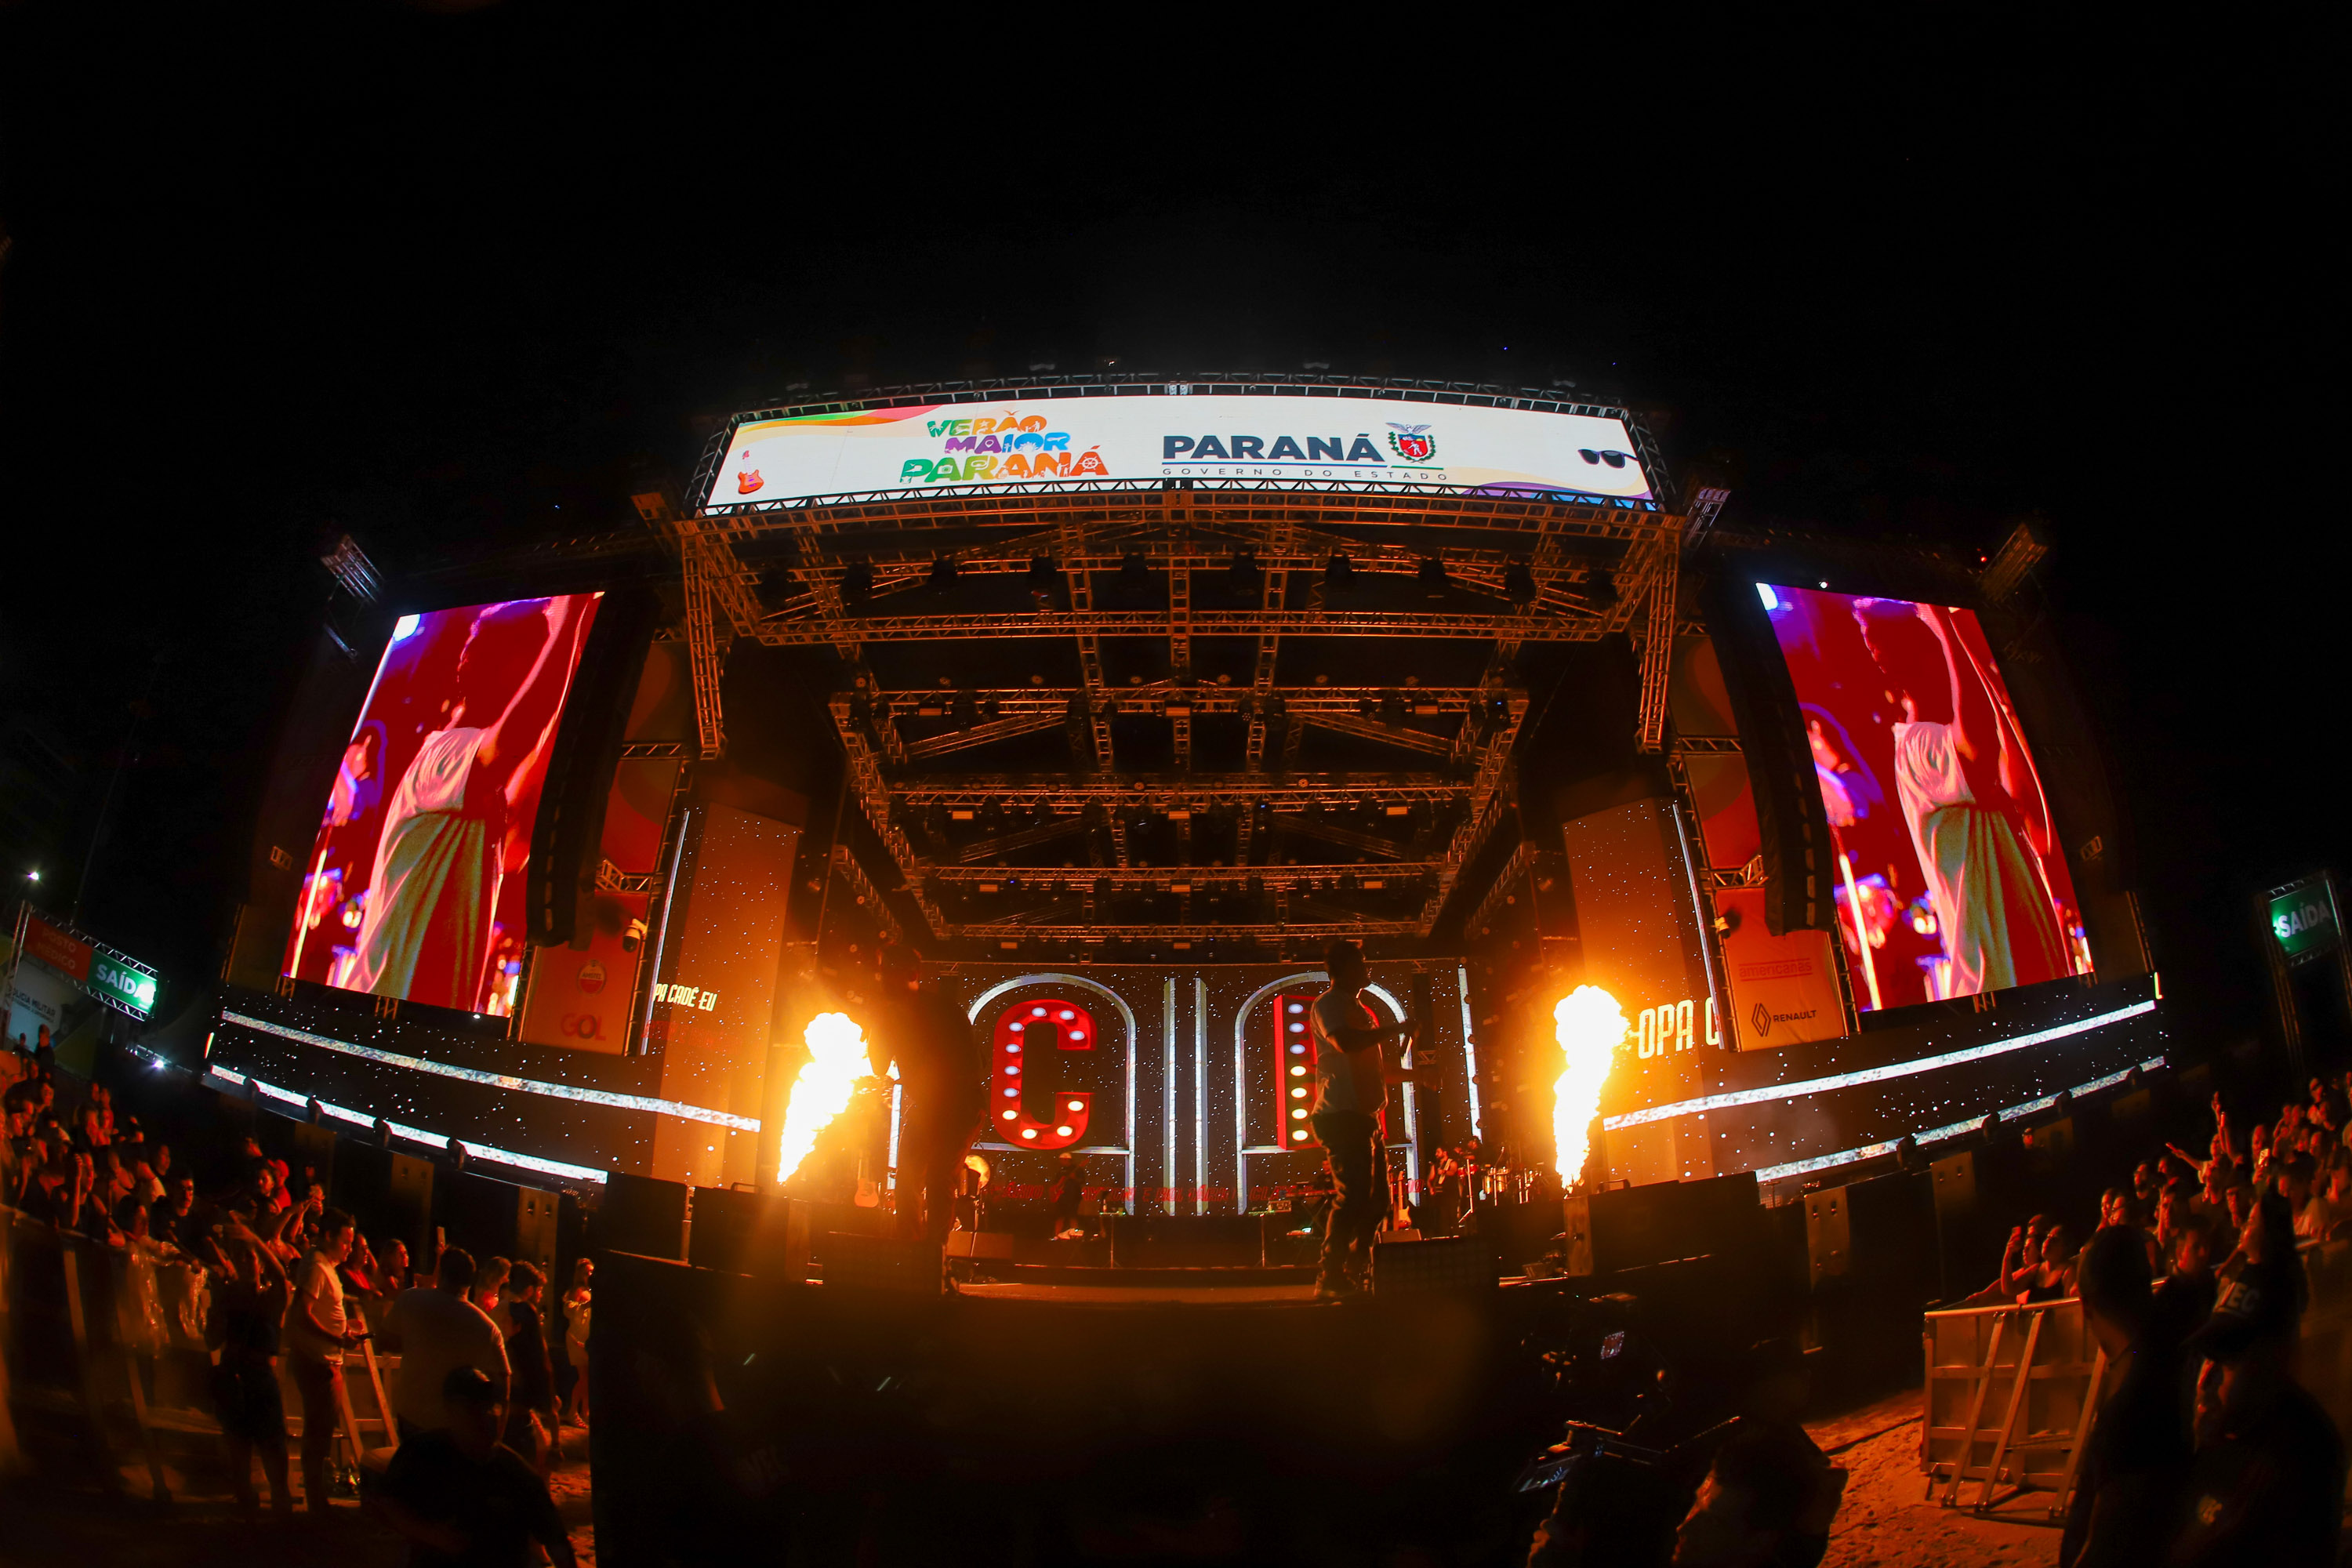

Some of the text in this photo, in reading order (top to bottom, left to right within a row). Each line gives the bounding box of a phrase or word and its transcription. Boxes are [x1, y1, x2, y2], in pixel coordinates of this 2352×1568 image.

[927, 410, 1047, 438] VERÃO
[944, 431, 1071, 454] MAIOR
[1163, 433, 1386, 463] PARANÁ
[899, 445, 1109, 485] PARANÁ
[1163, 468, 1447, 481] GOVERNO DO ESTADO
[2278, 901, 2332, 938] SAÍDA
[42, 927, 76, 953] POSTO
[1739, 961, 1813, 978] americanas
[699, 991, 717, 1011] EU
[561, 1011, 607, 1042] GOL
[1639, 1000, 1693, 1058] OPA
[1773, 1010, 1817, 1022] RENAULT
[991, 999, 1097, 1150] C
